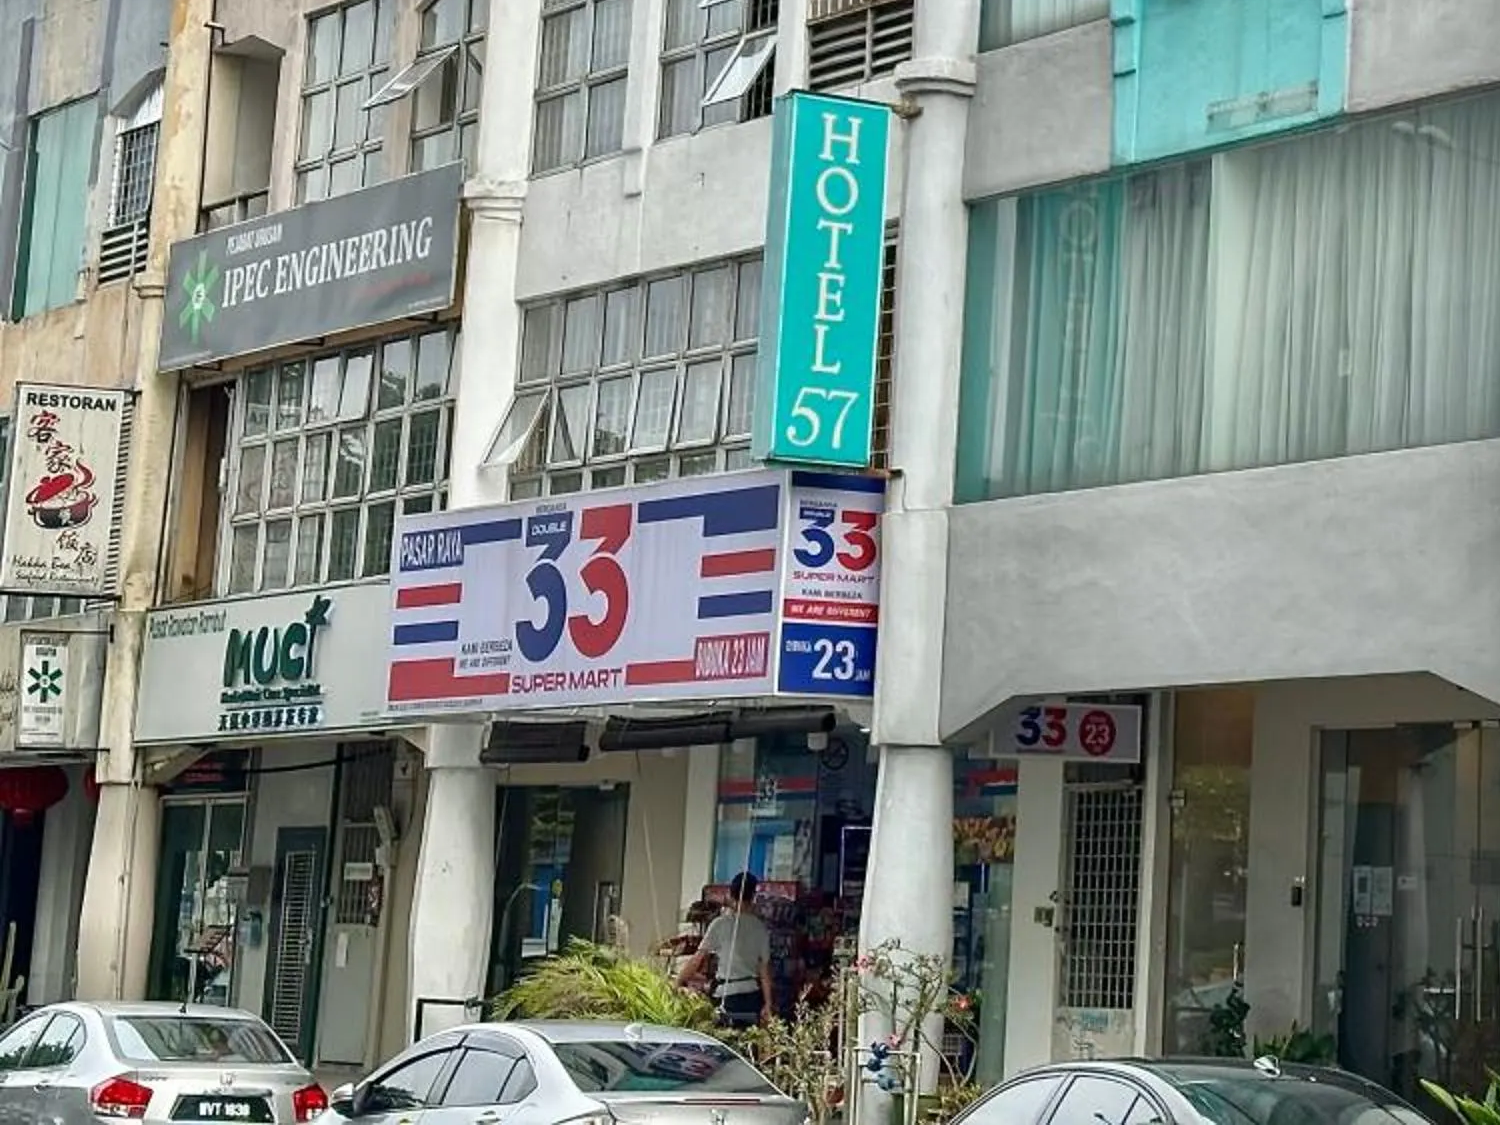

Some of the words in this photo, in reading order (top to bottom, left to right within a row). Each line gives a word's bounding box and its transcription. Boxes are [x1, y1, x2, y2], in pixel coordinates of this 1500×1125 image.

[221, 258, 272, 308] IPEC
[273, 216, 433, 295] ENGINEERING
[810, 111, 863, 376] HOTEL
[26, 392, 117, 412] RESTORAN
[785, 385, 860, 450] 57
[531, 520, 567, 536] DOUBLE
[794, 508, 876, 572] 33
[401, 533, 435, 570] PASAR
[436, 530, 463, 564] RAYA
[515, 503, 633, 663] 33
[793, 571, 834, 582] SUPER
[836, 574, 874, 583] MART
[806, 605, 824, 615] ARE
[812, 638, 855, 680] 23
[512, 673, 567, 693] SUPER
[569, 668, 623, 690] MART
[1016, 705, 1067, 747] 33
[1085, 724, 1110, 744] 23
